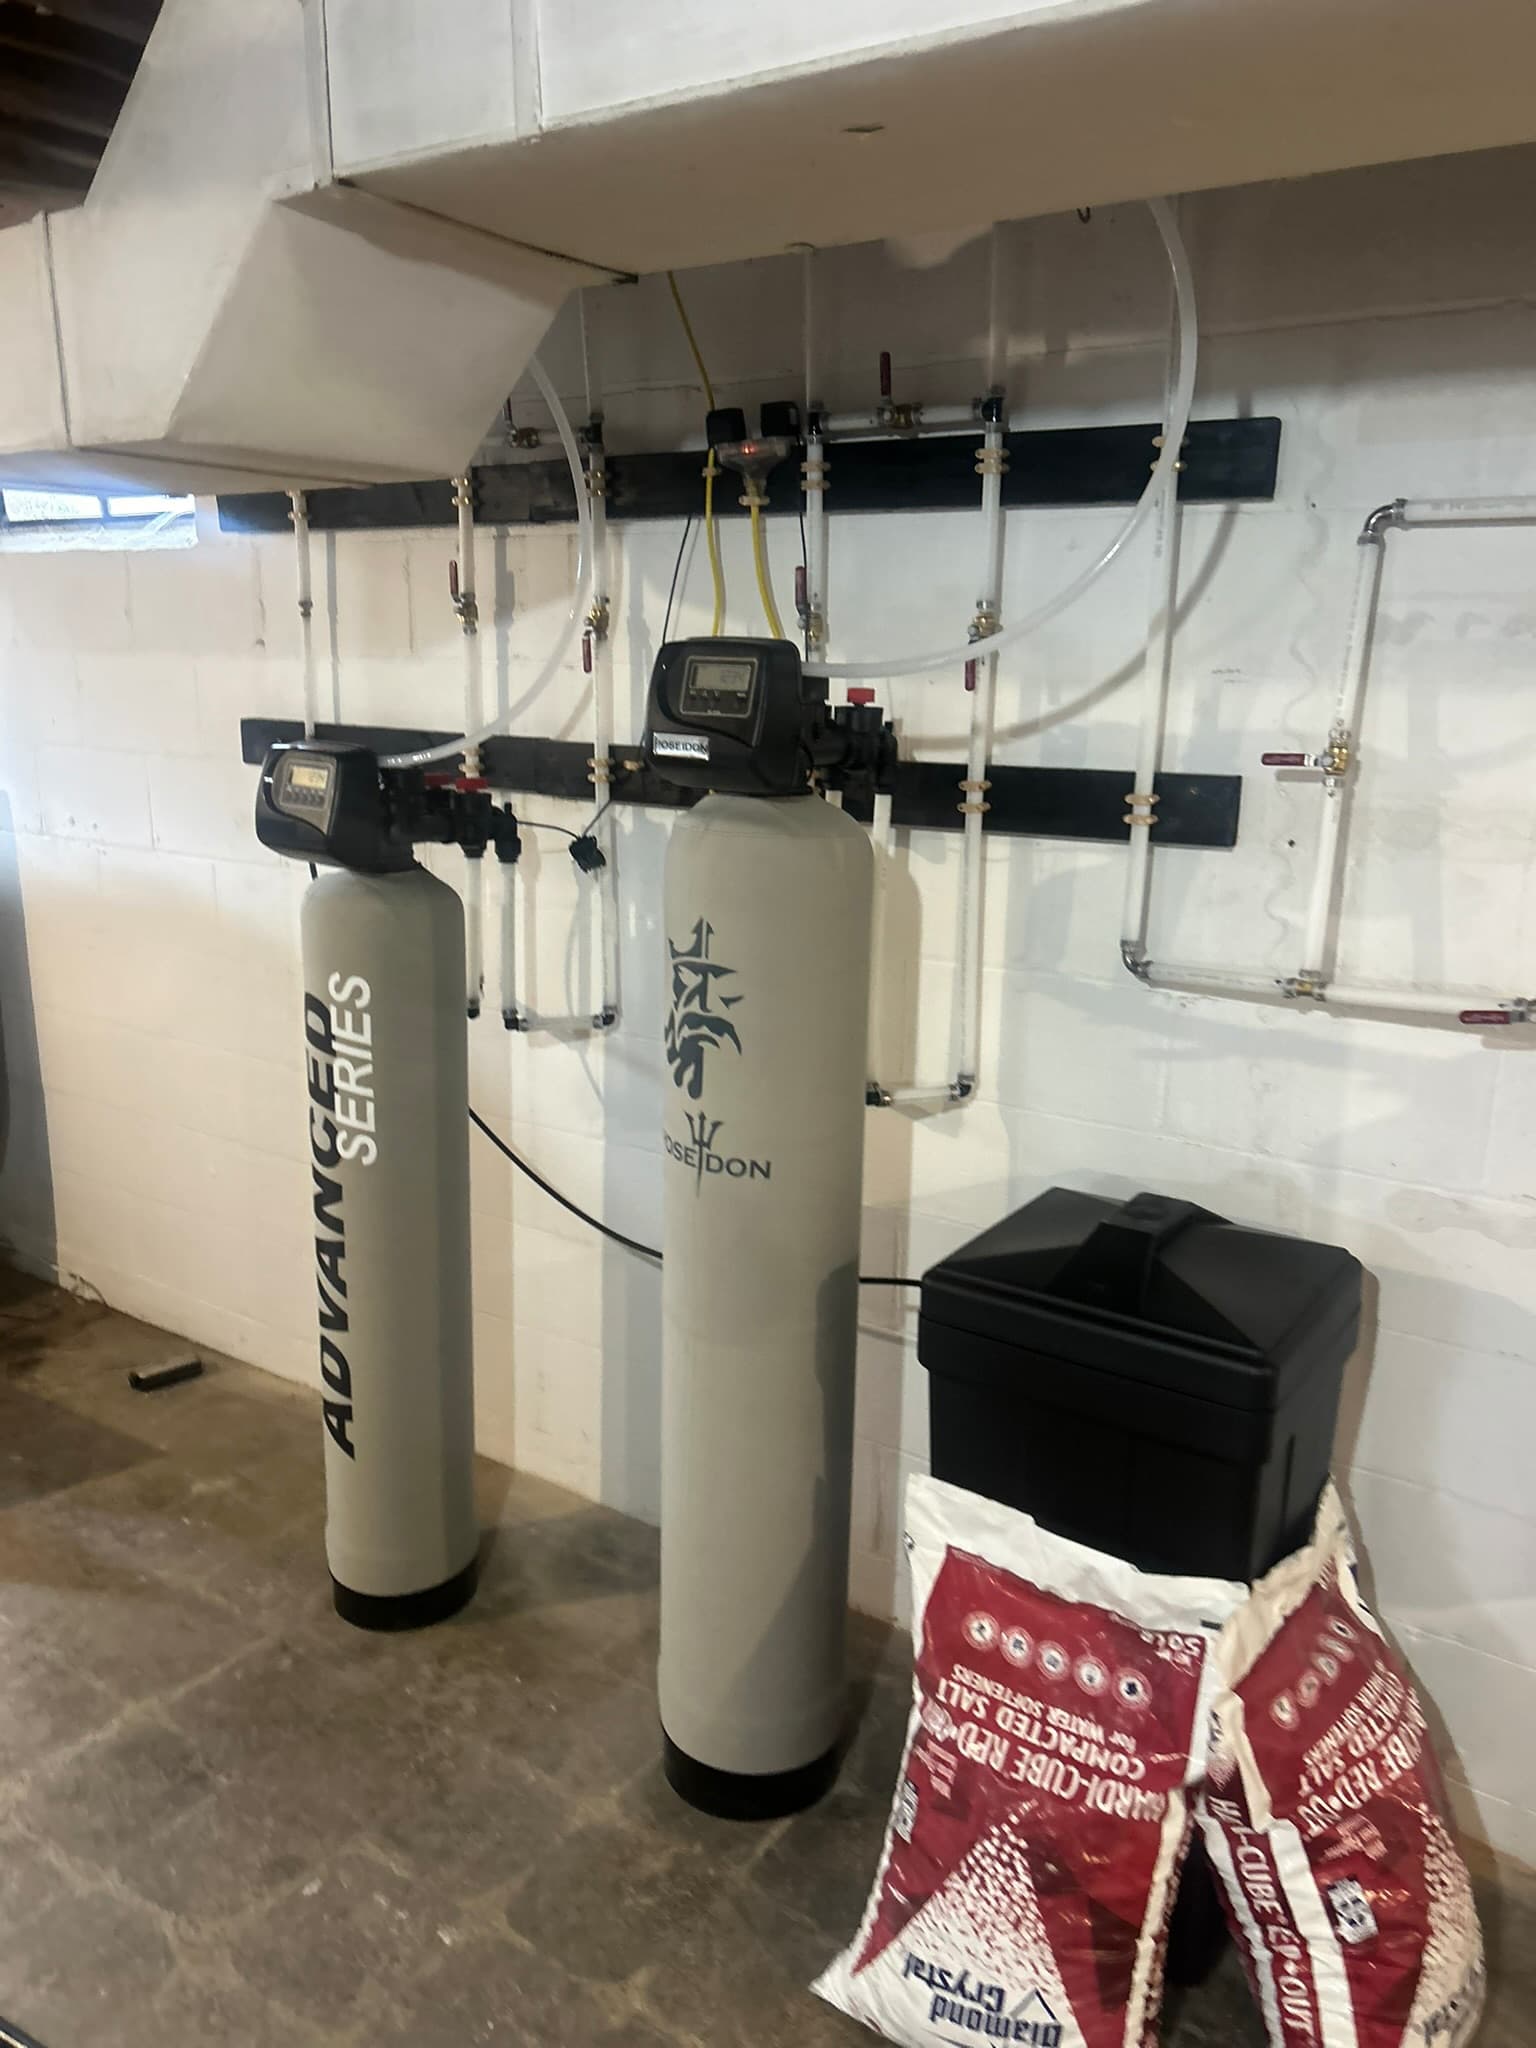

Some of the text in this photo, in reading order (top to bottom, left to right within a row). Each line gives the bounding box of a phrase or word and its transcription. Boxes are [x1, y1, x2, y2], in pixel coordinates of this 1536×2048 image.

[327, 971, 378, 1167] SERIES
[303, 991, 356, 1462] ADVANCED
[935, 1677, 991, 1720] SALT
[950, 1663, 1045, 1718] SOFTENERS
[995, 1702, 1147, 1781] COMPACTED
[1047, 1705, 1106, 1746] WATER
[902, 1950, 1006, 2014] Crystal
[928, 1993, 1064, 2048] Diamond
